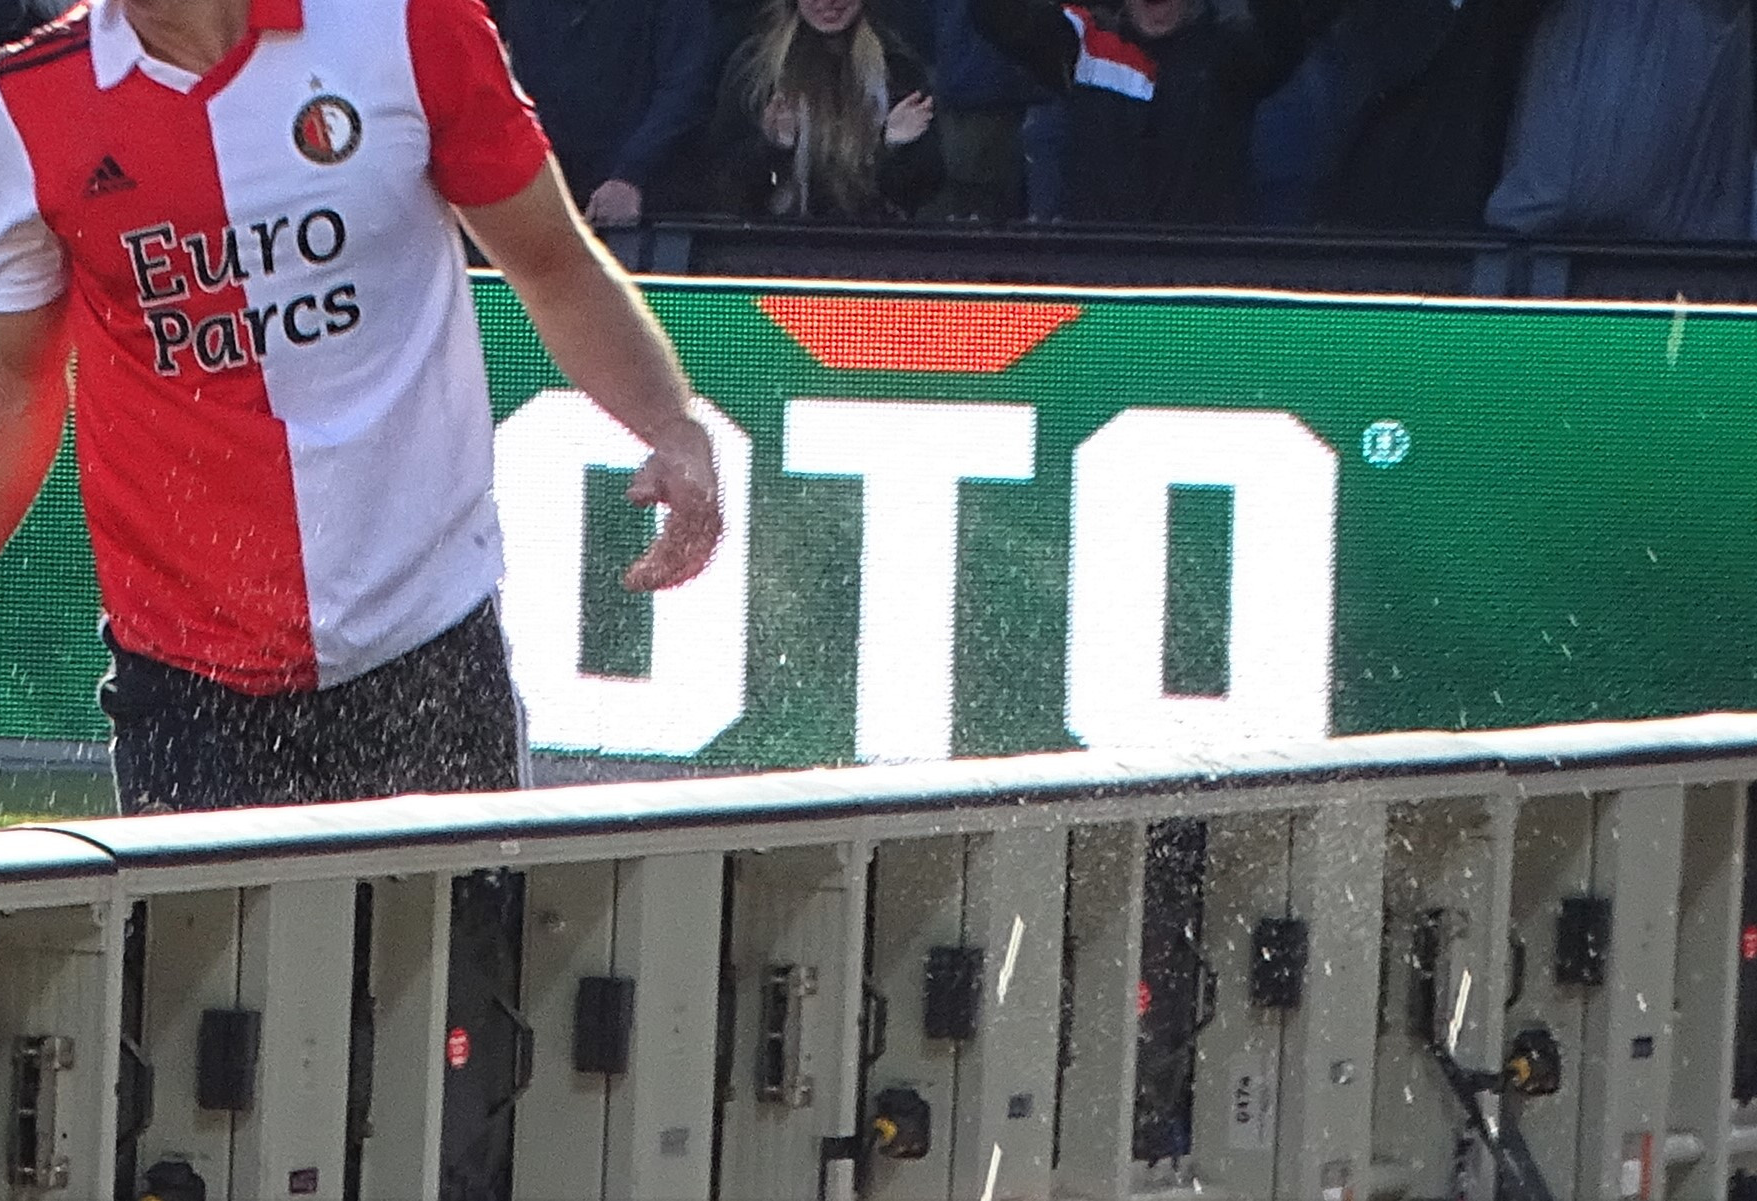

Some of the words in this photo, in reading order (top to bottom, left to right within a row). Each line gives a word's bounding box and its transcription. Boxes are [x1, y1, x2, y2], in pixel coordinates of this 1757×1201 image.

[120, 207, 346, 307] Euro
[143, 282, 362, 377] Parcs
[493, 387, 1341, 763] OTO
